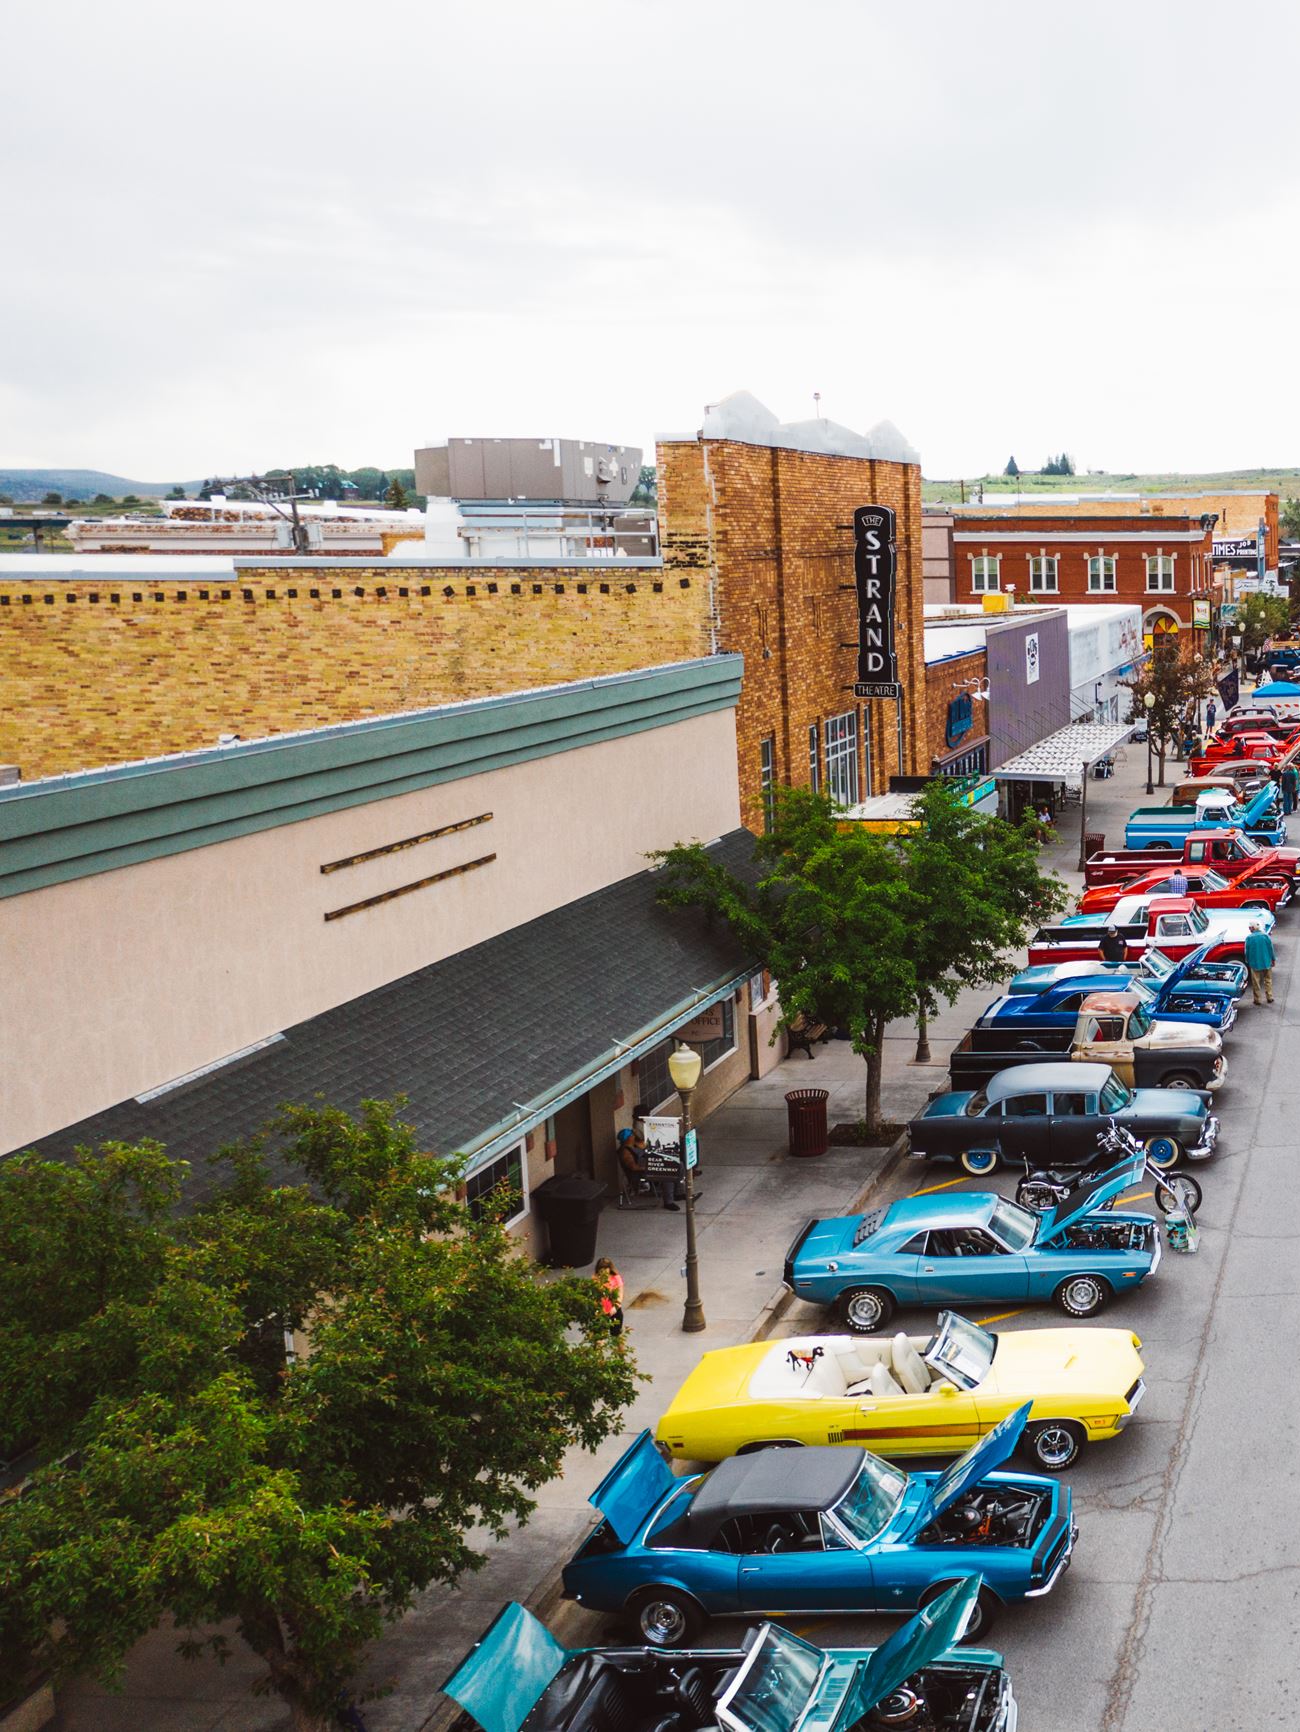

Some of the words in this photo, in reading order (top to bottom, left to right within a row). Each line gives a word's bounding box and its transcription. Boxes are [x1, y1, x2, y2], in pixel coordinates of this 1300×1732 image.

[864, 516, 881, 526] THE
[865, 529, 884, 673] STRAND
[857, 685, 896, 696] THEATRE
